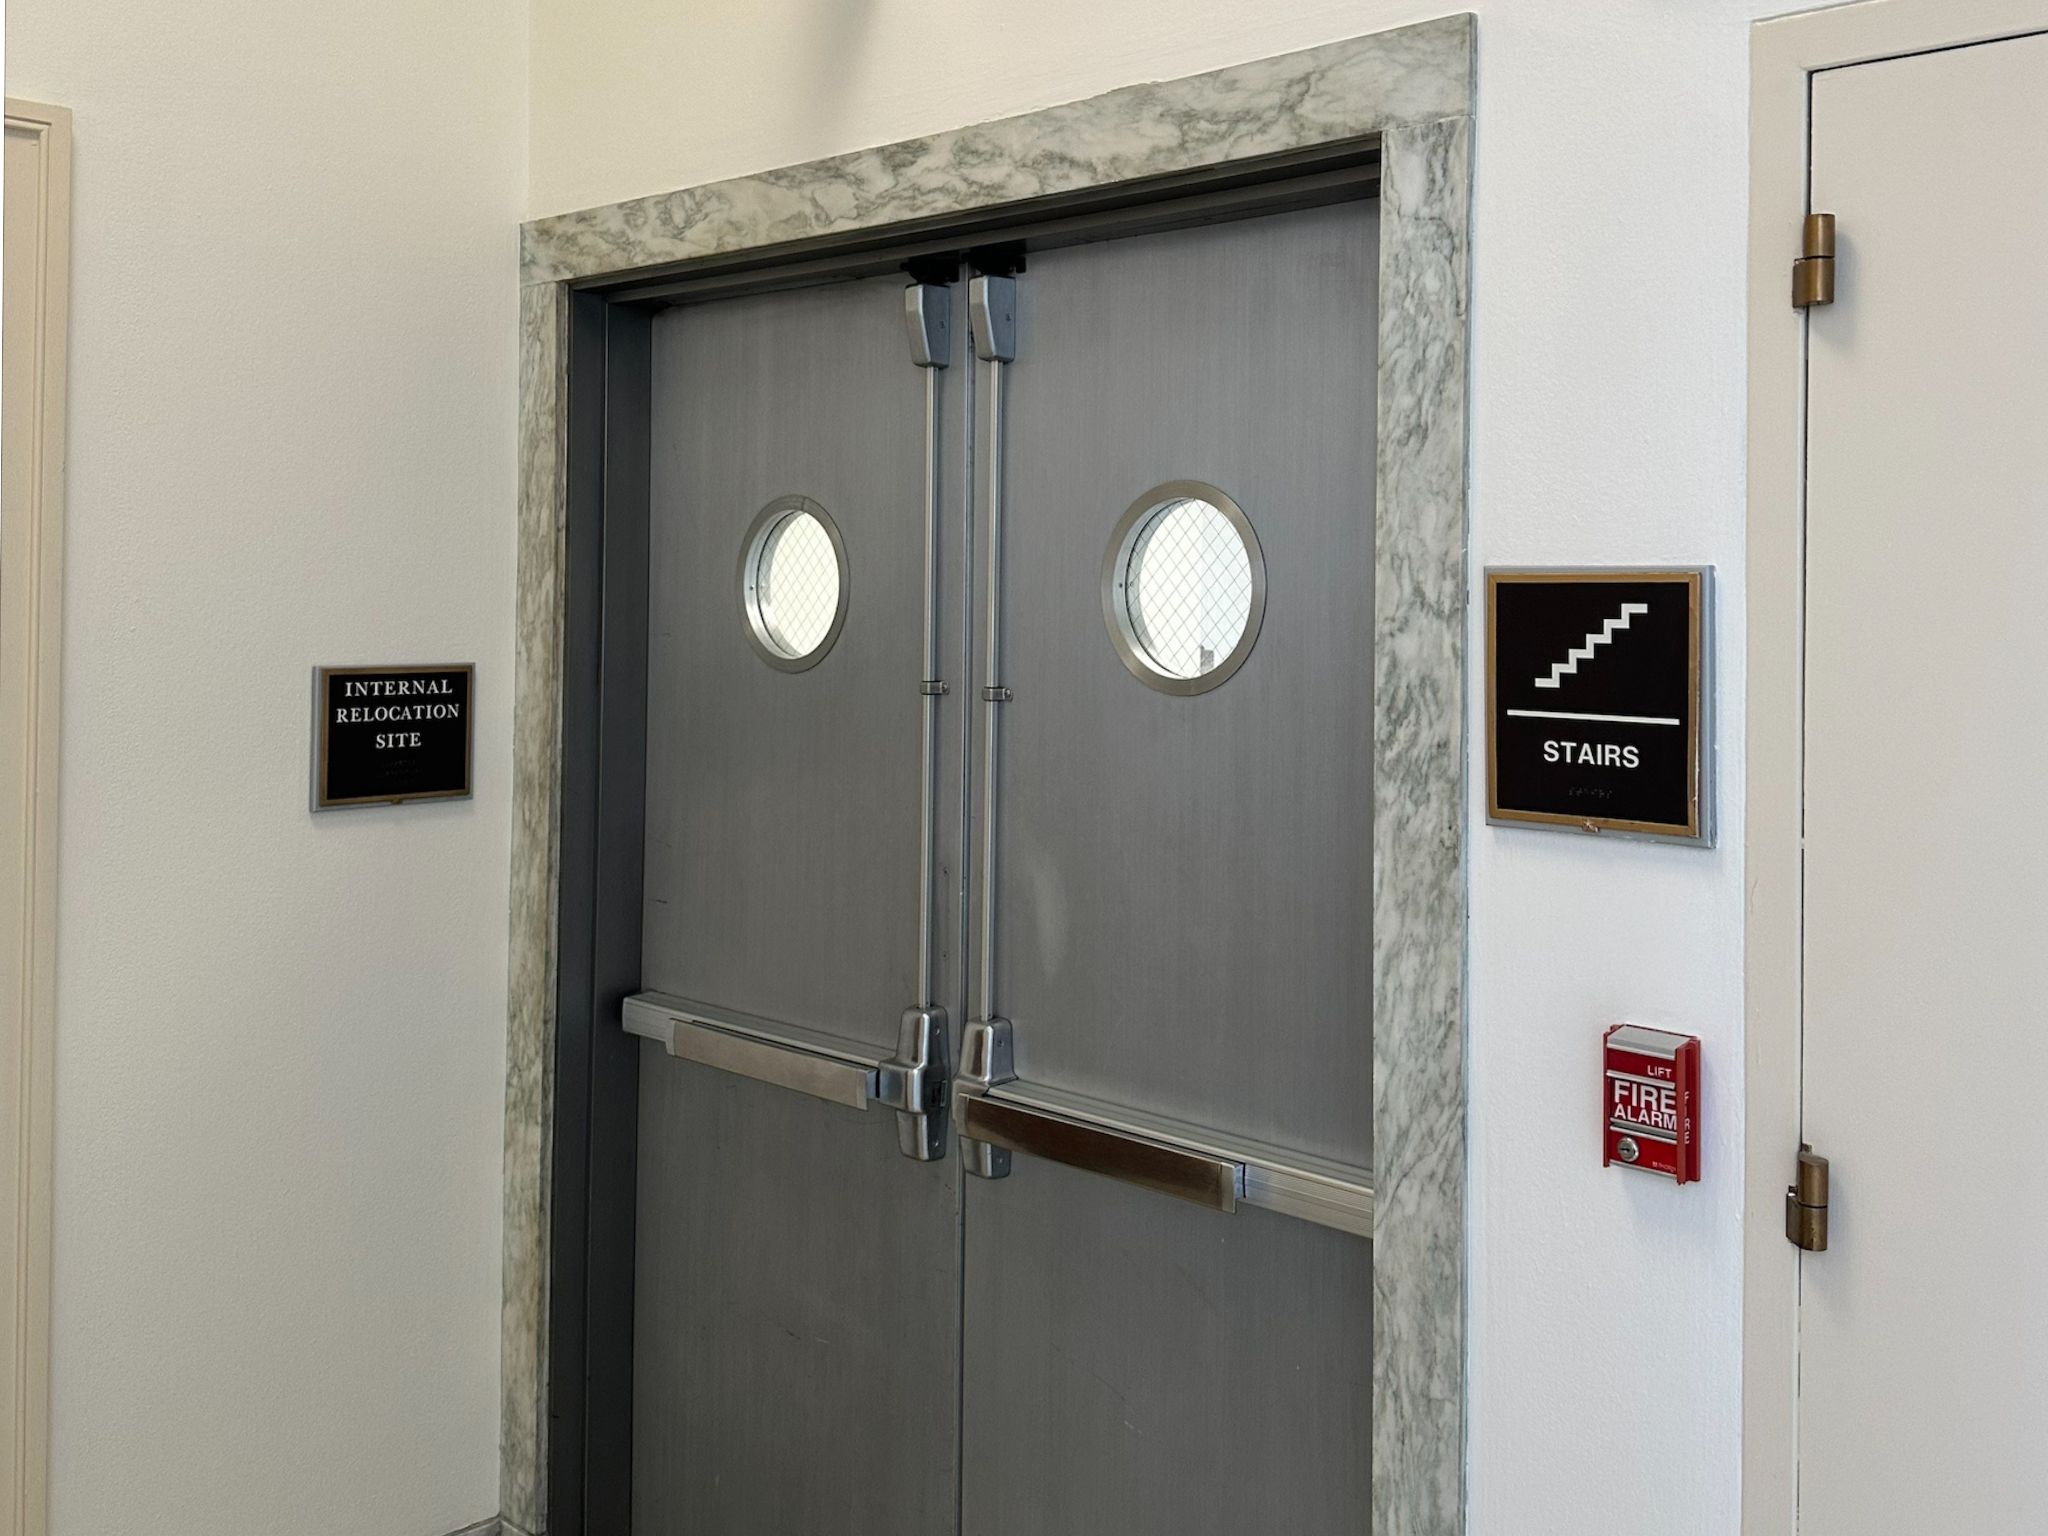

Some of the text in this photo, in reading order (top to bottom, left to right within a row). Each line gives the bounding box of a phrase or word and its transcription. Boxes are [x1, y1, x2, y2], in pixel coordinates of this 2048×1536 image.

[345, 679, 453, 697] INTERNAL
[336, 703, 460, 723] RELOCATION
[375, 732, 422, 749] SITE
[1543, 740, 1640, 768] STAIRS
[1647, 1065, 1673, 1079] LIFT
[1614, 1079, 1677, 1115] FIRE
[1614, 1103, 1677, 1130] ALARM
